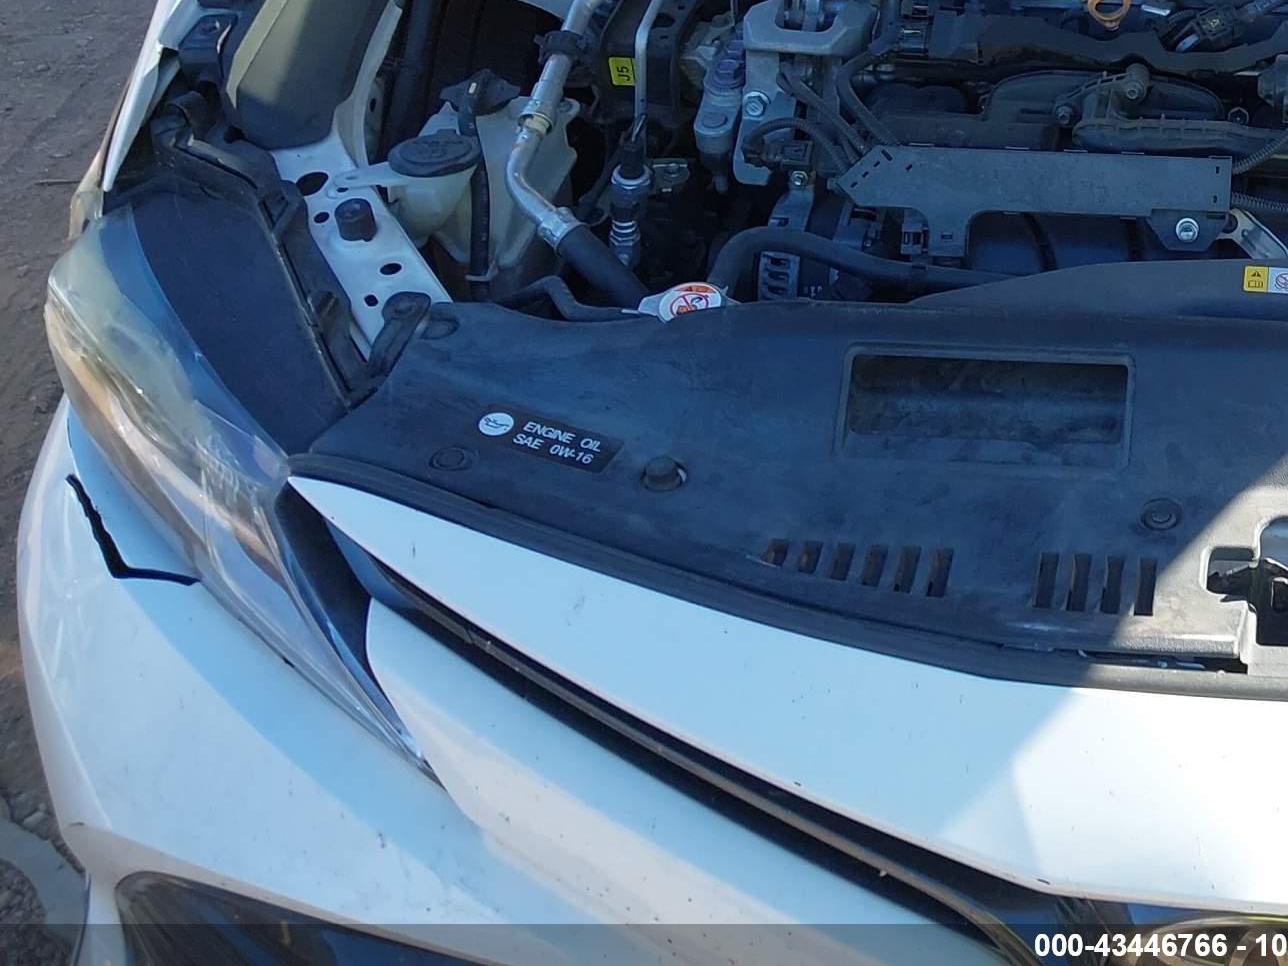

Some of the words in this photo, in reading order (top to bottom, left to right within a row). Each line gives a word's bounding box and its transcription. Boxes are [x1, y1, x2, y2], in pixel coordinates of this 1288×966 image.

[616, 65, 631, 82] J5
[513, 433, 544, 450] SAE
[549, 444, 594, 464] 0W-16
[523, 421, 576, 444] ENGINE
[580, 438, 601, 452] OIL
